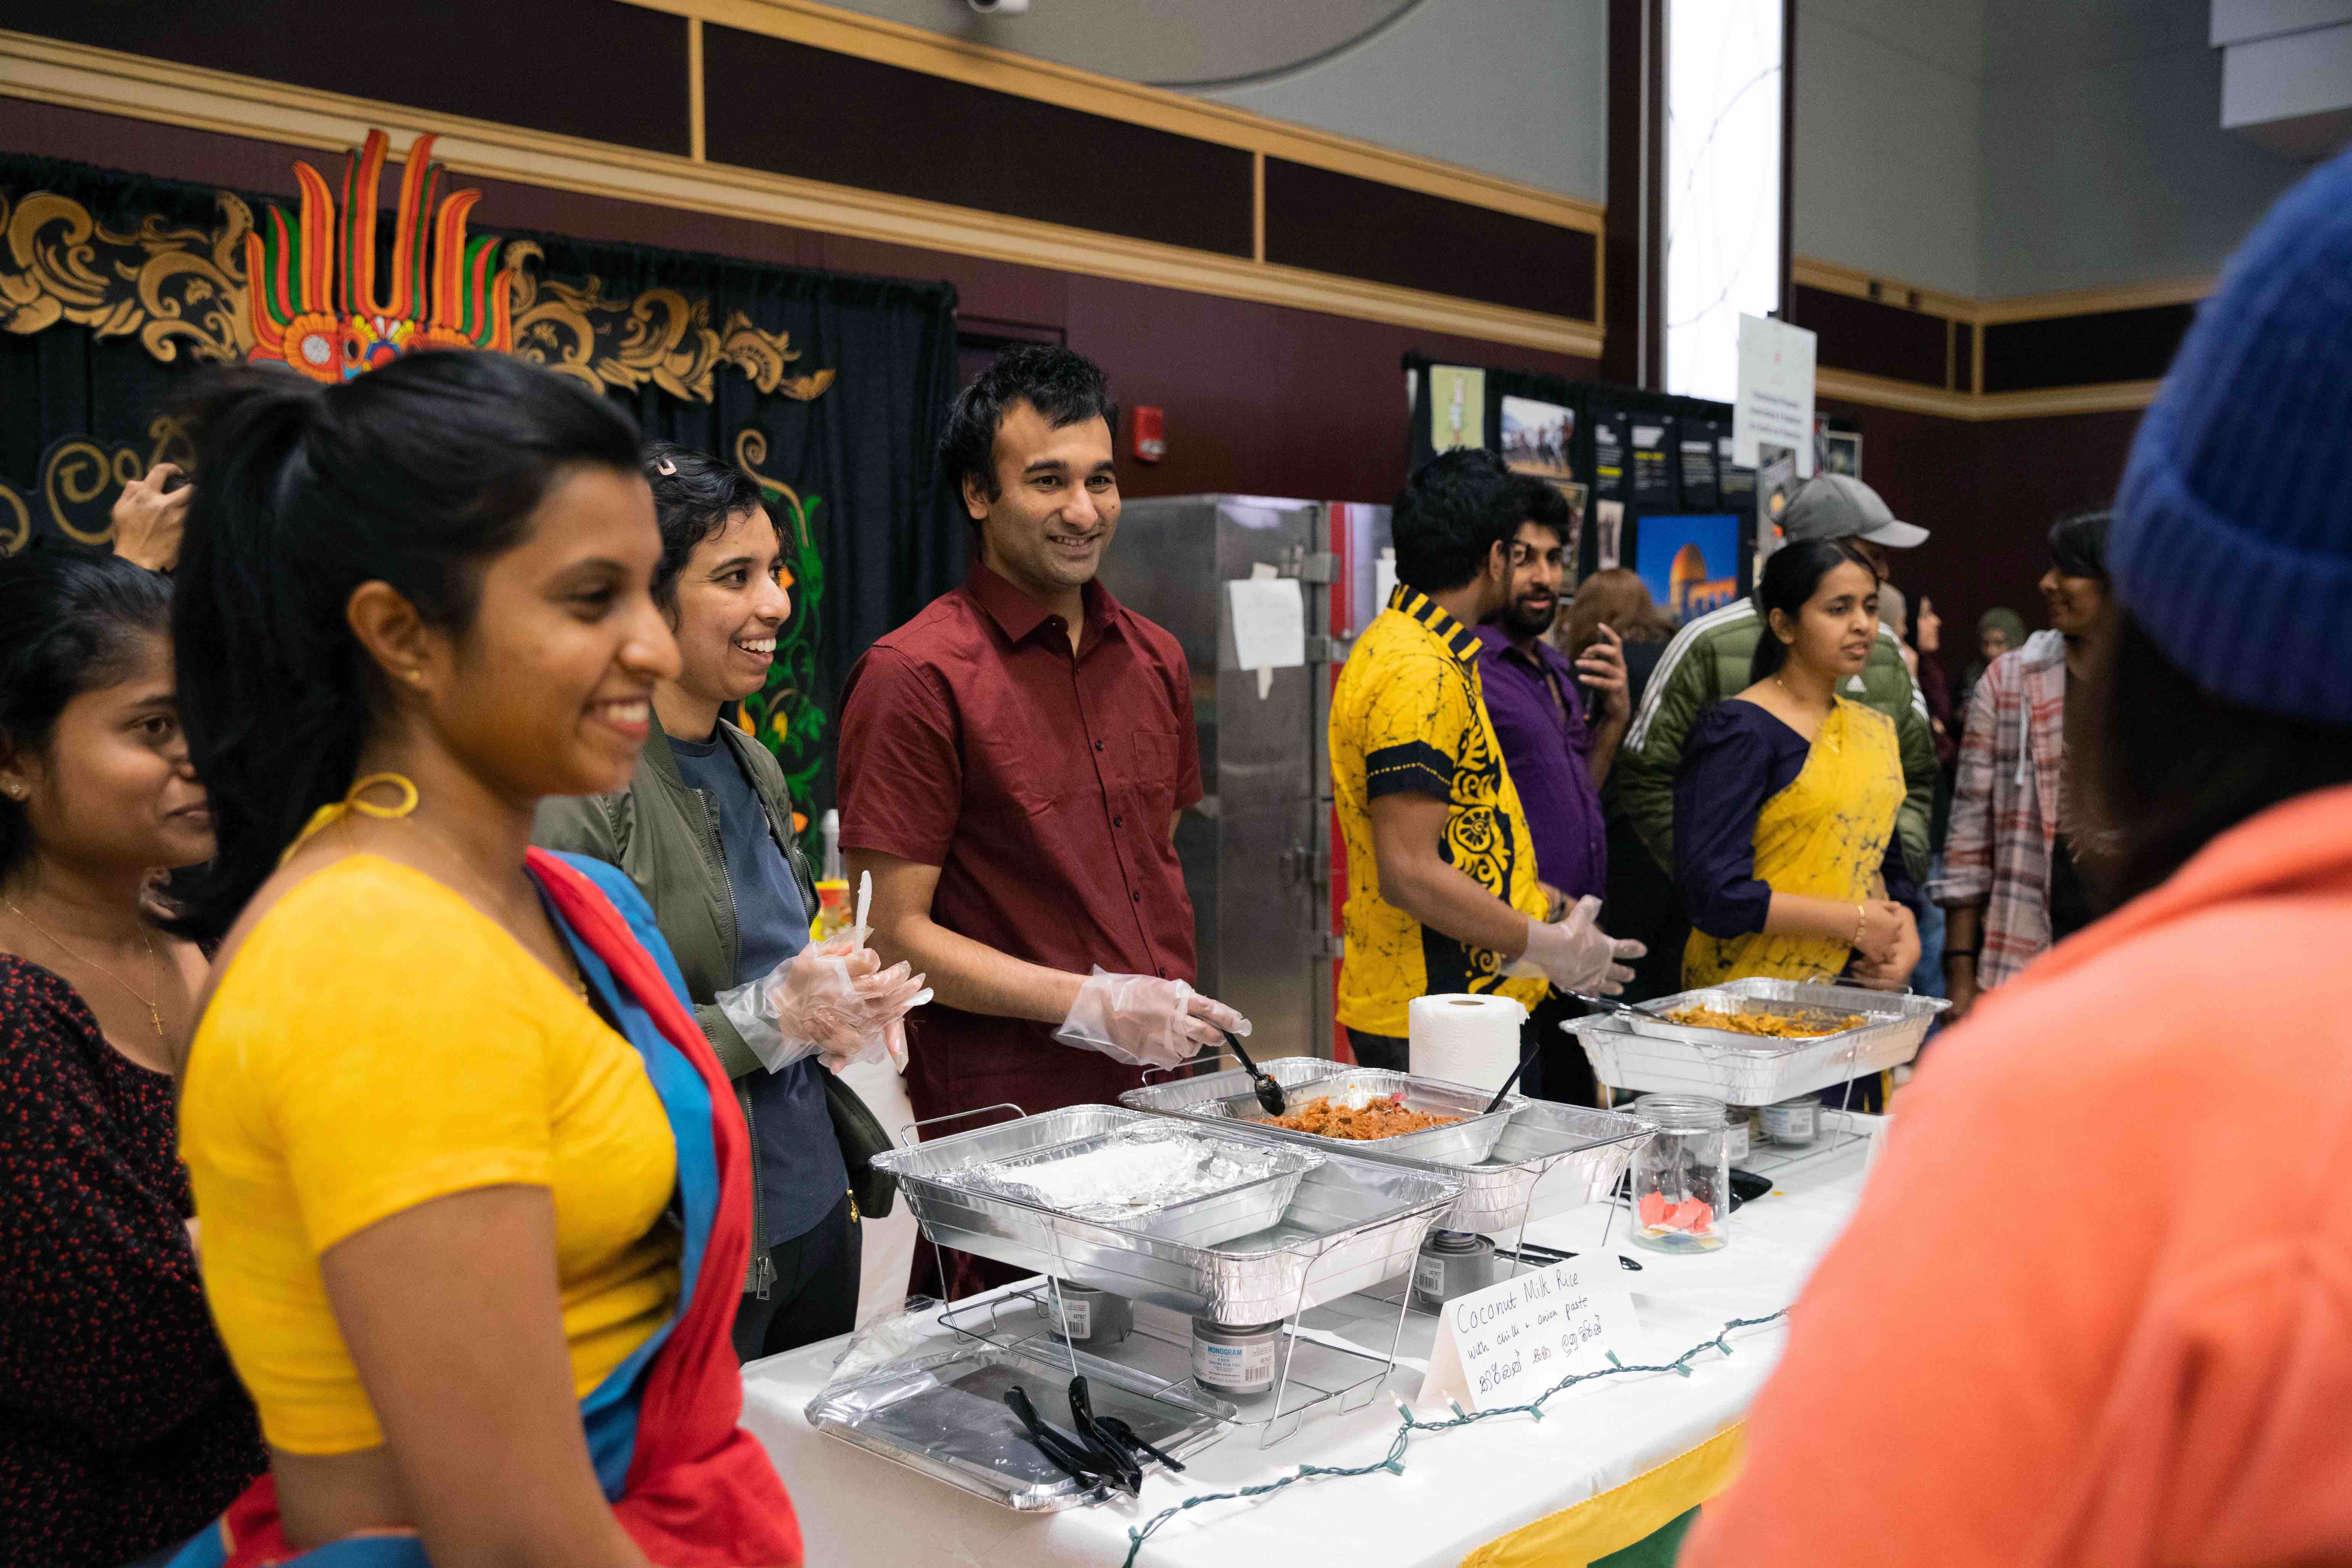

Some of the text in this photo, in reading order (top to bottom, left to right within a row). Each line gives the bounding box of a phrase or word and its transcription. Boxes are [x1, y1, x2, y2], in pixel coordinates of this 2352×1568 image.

[1457, 1269, 1579, 1333] Coconut Milk Rice
[1468, 1341, 1489, 1359] with
[1565, 1296, 1588, 1321] paste
[1208, 1346, 1242, 1355] MONOGRAM
